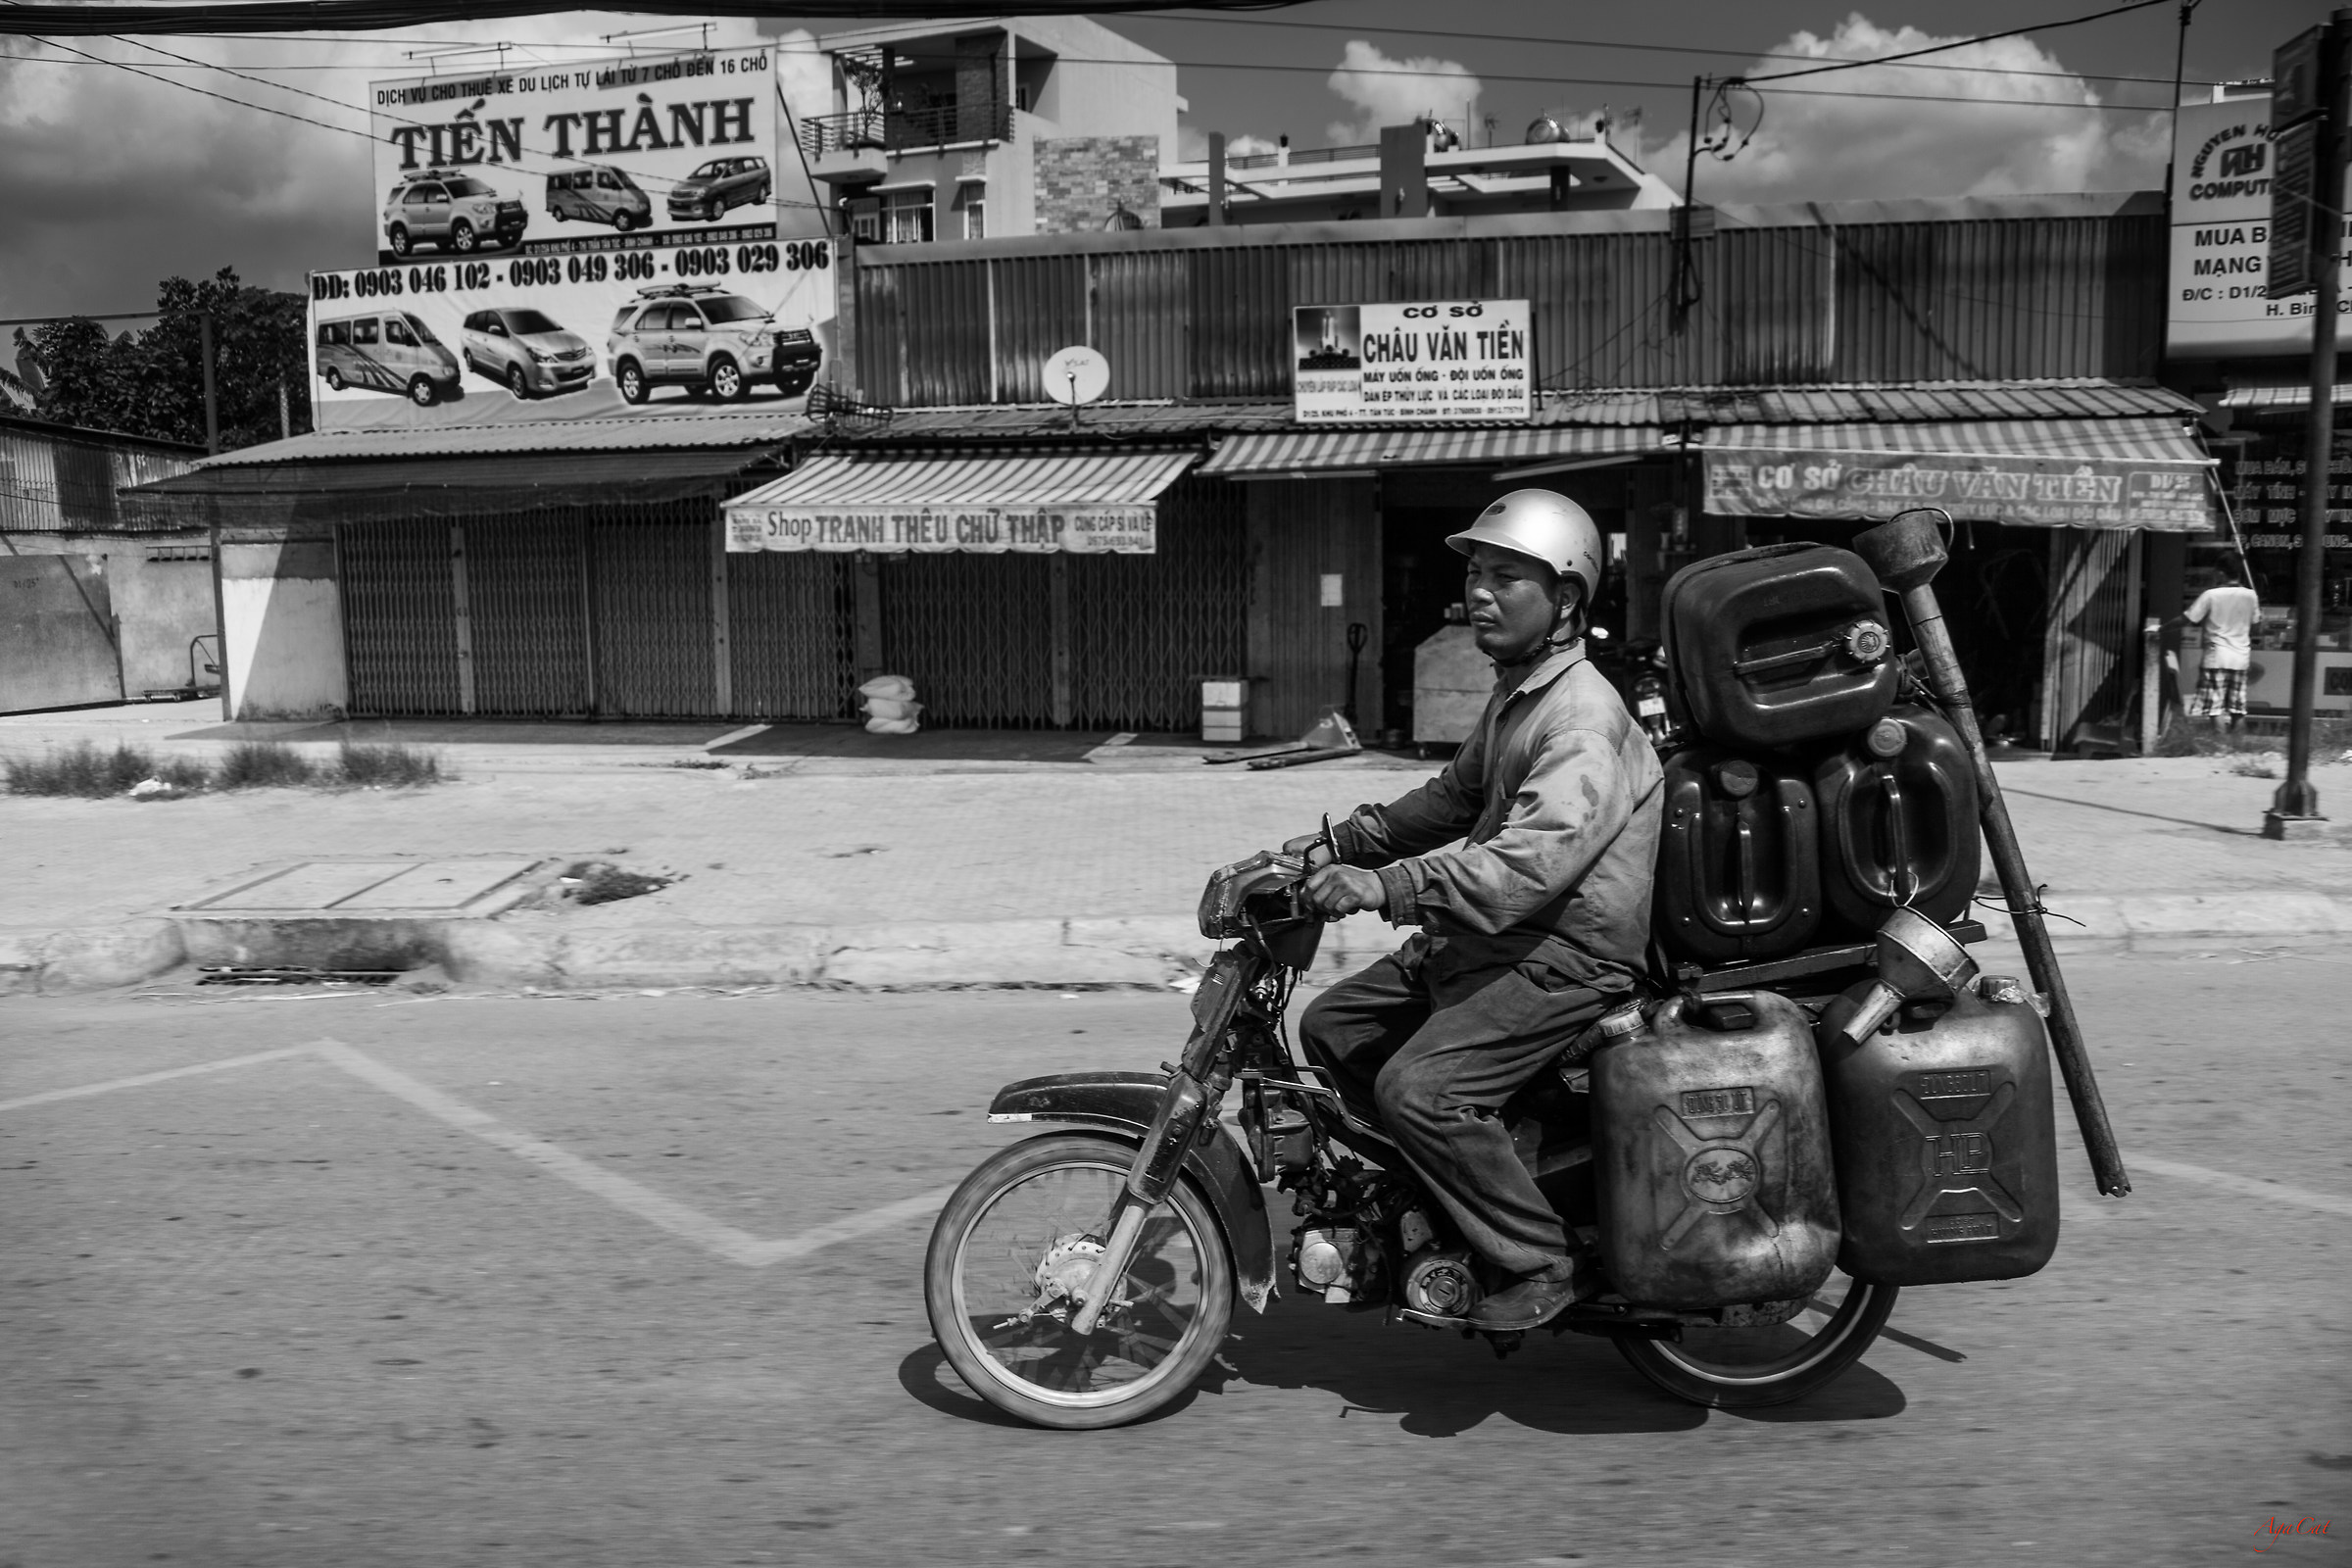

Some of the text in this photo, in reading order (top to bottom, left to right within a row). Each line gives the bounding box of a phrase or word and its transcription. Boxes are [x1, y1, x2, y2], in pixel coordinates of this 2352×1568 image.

[377, 49, 768, 107] DỊCH VỤ CHO THUÊ XE DU LỊCH TỰ LÁI TỪ 7 CHỖ ĐẾN 16 CHỖ
[392, 92, 756, 171] TIẾN THÀNH
[2194, 227, 2245, 248] MUA
[355, 269, 404, 298] 0903
[409, 266, 447, 294] 046
[454, 262, 490, 291] 102
[510, 257, 562, 287] 0903
[567, 254, 608, 283] 049
[613, 250, 655, 280] 306
[674, 247, 730, 277] 0903
[737, 244, 779, 273] 029
[786, 240, 829, 270] 306
[2194, 256, 2262, 278] MẠNG
[2230, 284, 2268, 300] D1/2
[1363, 318, 1524, 364] CHÂU VĂN TIỀN
[1363, 364, 1524, 384] MÁY UỐN ỐNG ĐỘI UỐN ỐNG
[1757, 463, 1795, 489] CƠ
[1803, 459, 1842, 490] SỞ
[1844, 463, 1949, 498] CHÂU
[1952, 466, 2031, 499] VĂN
[768, 511, 811, 544] Shop
[815, 514, 884, 543] TRANH
[891, 507, 949, 543] THÊU
[956, 508, 1001, 543] CHỮ
[1005, 507, 1066, 550] THẬP
[1925, 1132, 1989, 1177] HP
